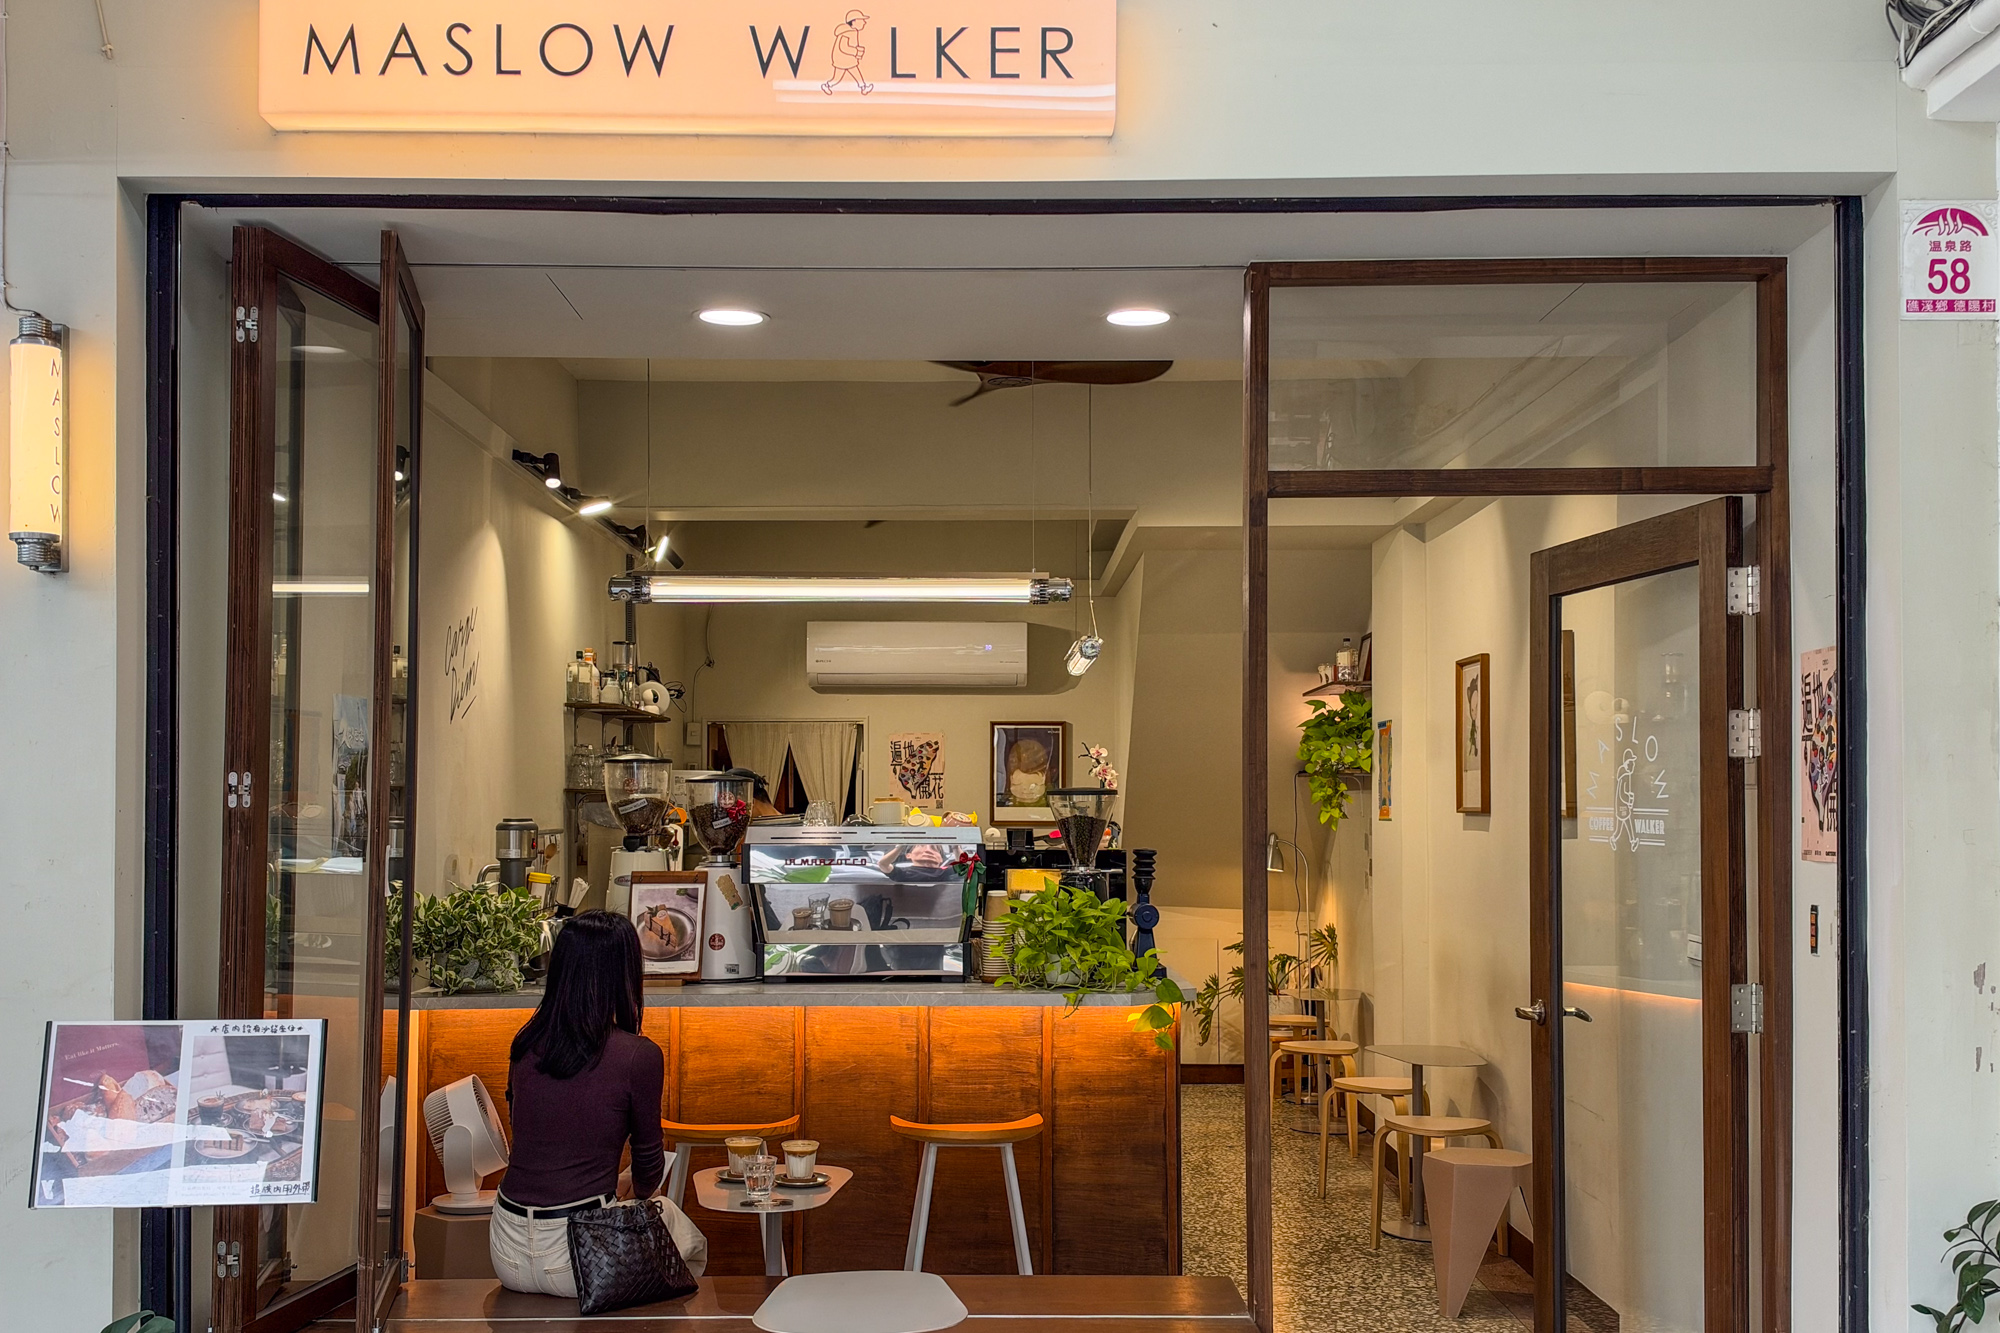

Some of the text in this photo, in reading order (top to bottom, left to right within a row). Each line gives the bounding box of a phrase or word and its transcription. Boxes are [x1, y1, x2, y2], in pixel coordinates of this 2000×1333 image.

[302, 22, 675, 77] MASLOW
[1927, 258, 1971, 294] 58
[1907, 299, 1995, 312] 礁溪鄉 德陽村
[1589, 816, 1665, 834] COFFEE WALKER
